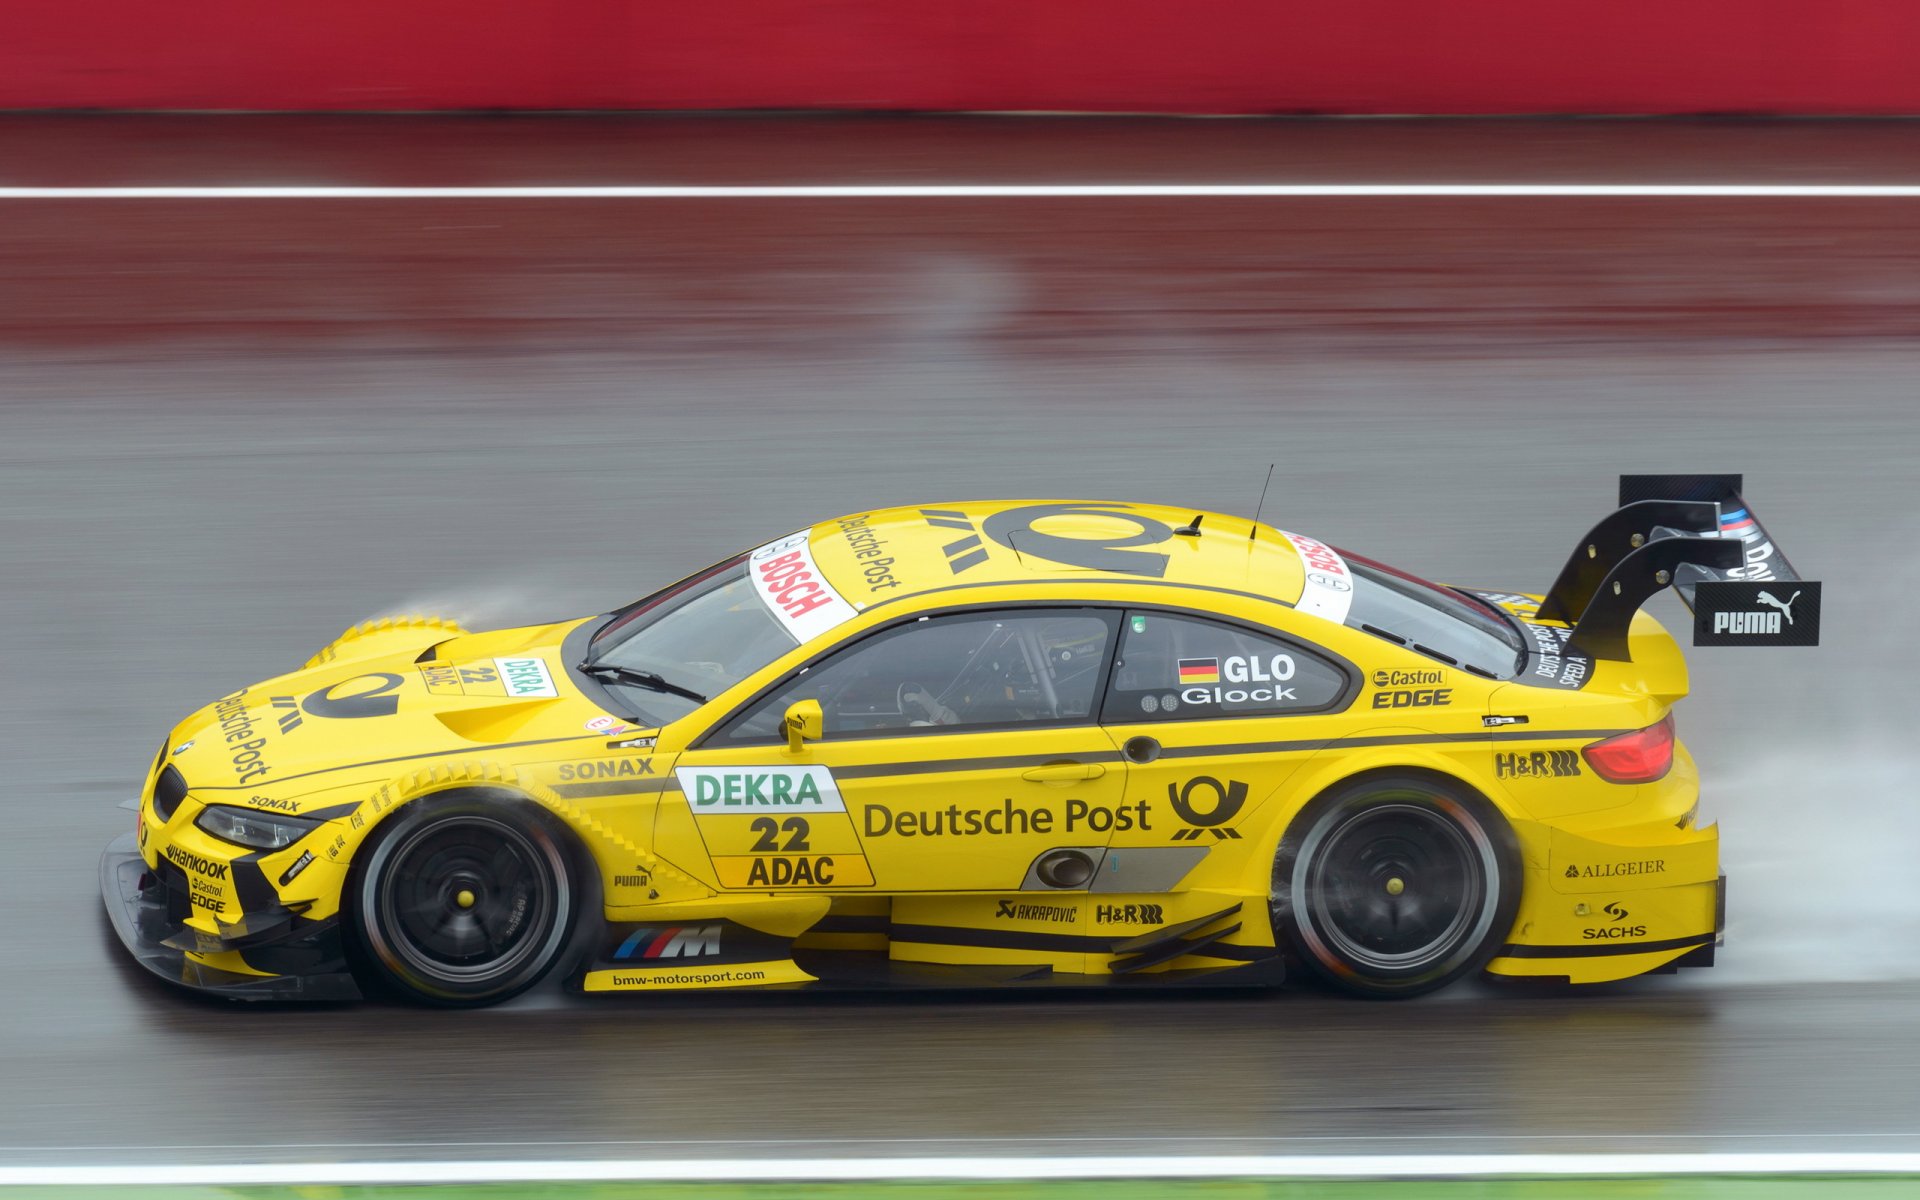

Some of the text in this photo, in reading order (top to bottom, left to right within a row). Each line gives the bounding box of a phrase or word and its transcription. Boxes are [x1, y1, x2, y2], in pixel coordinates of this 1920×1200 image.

[836, 514, 902, 592] Deutsche Post
[759, 550, 833, 619] BOSCH
[1525, 623, 1557, 642] POST
[1714, 612, 1781, 634] PUMA
[424, 665, 458, 686] ADAC
[459, 667, 497, 684] 22
[504, 660, 546, 694] DEKRA
[1224, 654, 1296, 682] GLO
[1390, 669, 1443, 686] Castrol
[1559, 663, 1586, 688] SPEED
[1181, 684, 1298, 705] Glock
[1371, 688, 1453, 710] EDGE
[214, 688, 271, 784] Deutsche Post
[558, 758, 656, 781] SONAX
[695, 773, 823, 806] DEKRA
[248, 795, 302, 813] SONAX
[864, 799, 1152, 838] Deutsche Post
[749, 817, 810, 852] 22
[746, 856, 834, 886] ADAC
[1582, 860, 1665, 878] ALLGEIER
[198, 880, 223, 897] Castrol
[614, 875, 648, 887] PUMA
[191, 892, 226, 913] EDGE
[1017, 905, 1077, 923] AKRAPOVIČ
[1582, 925, 1648, 940] SACHS
[612, 969, 765, 987] bmw-motorsport.com
